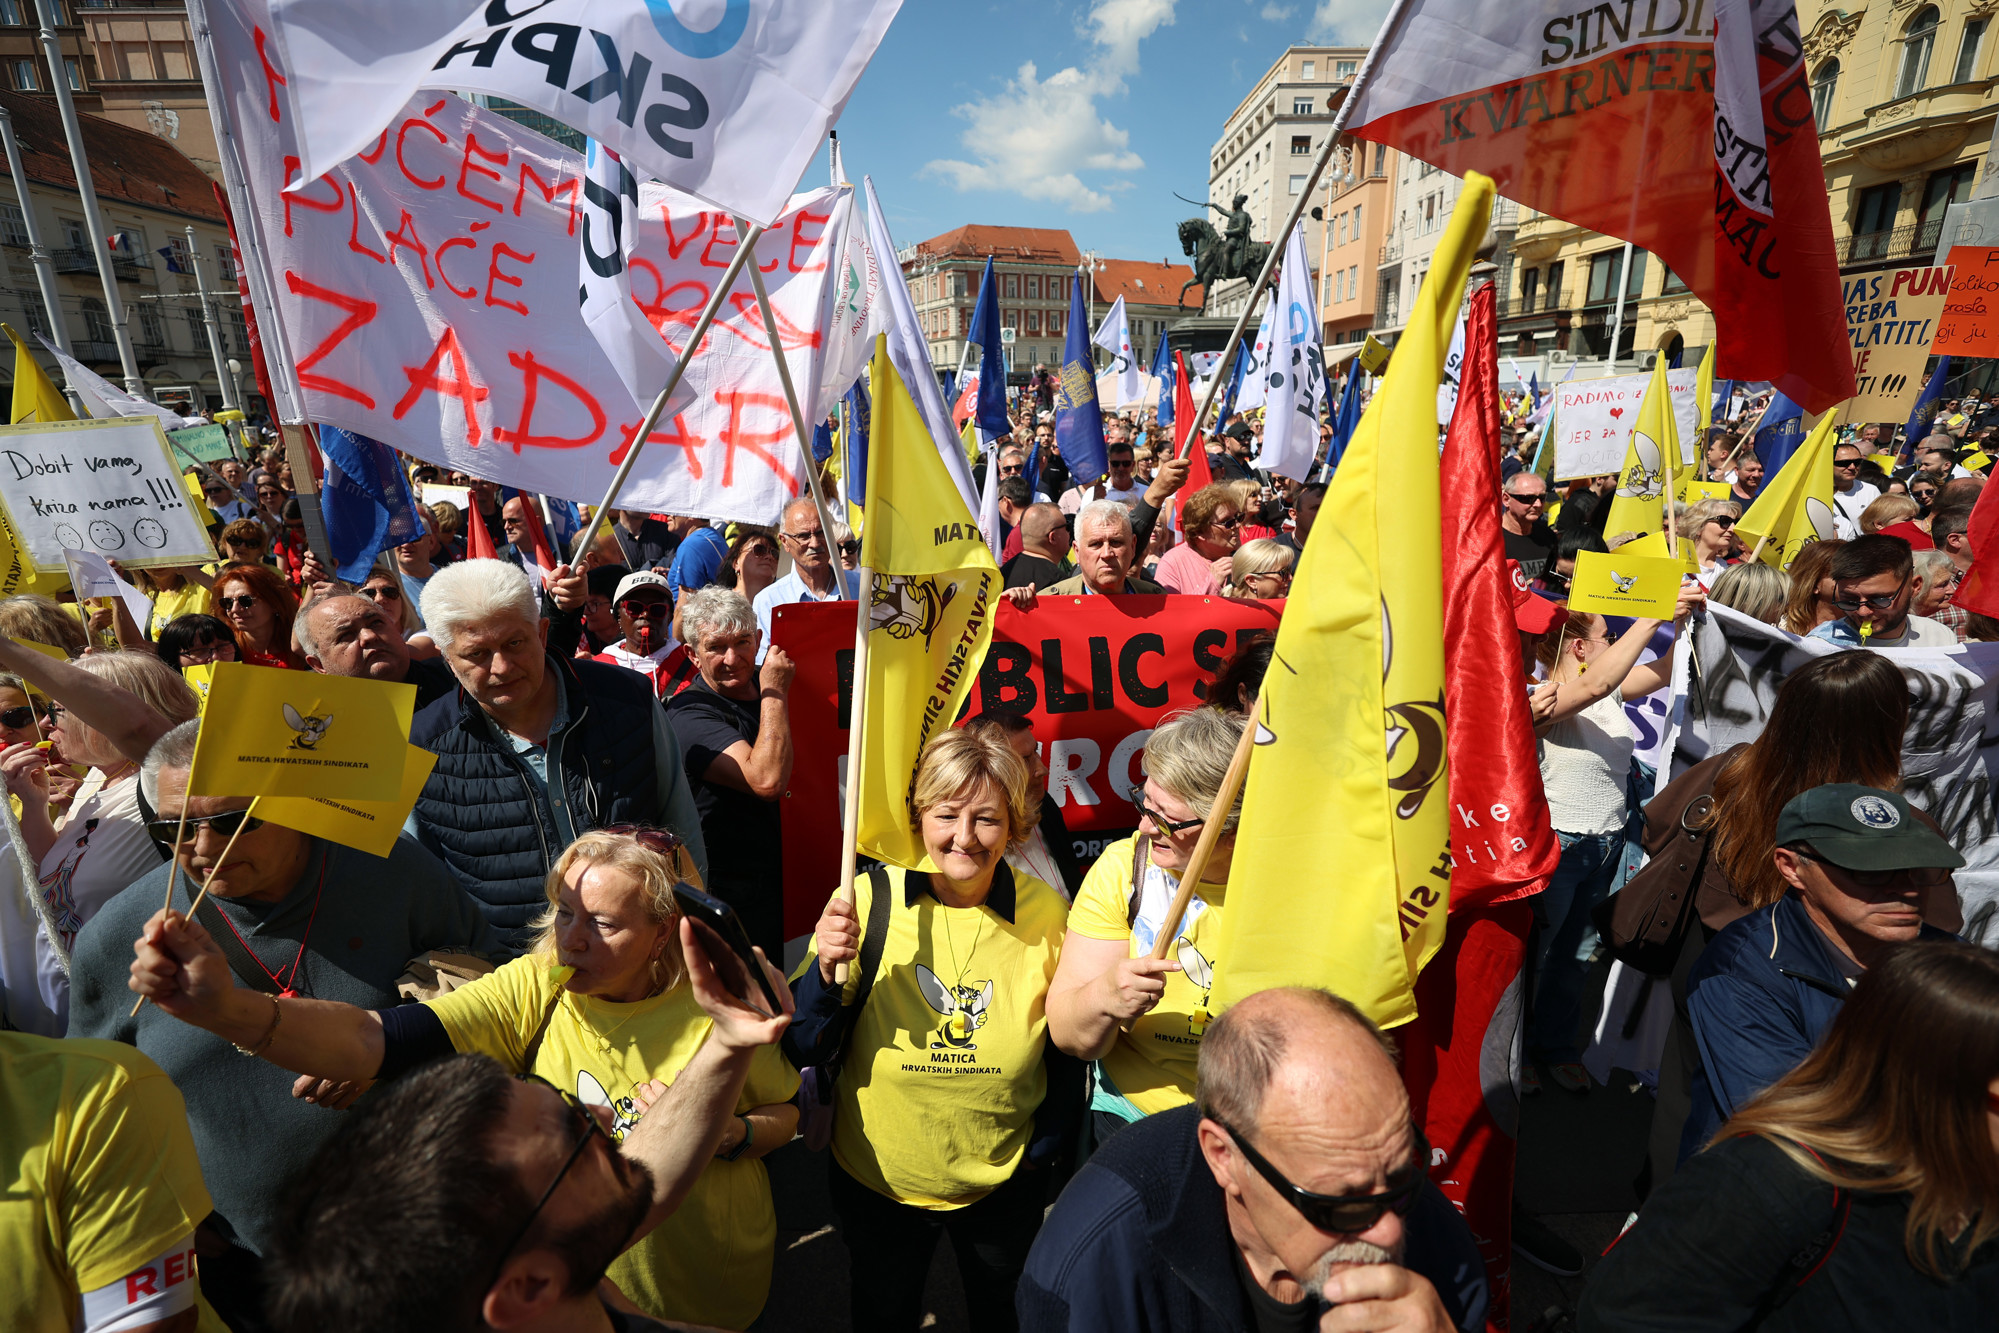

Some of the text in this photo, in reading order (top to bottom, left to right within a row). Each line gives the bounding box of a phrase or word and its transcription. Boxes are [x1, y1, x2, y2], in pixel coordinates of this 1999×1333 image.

[1542, 0, 1714, 66] SINDI
[1846, 300, 1897, 324] REBA
[286, 269, 799, 498] ZADAR
[1563, 391, 1625, 409] RADIMO
[3, 450, 143, 481] Dobit vama,
[934, 521, 984, 547] MATI
[238, 755, 369, 769] MATICA HRVATSKIH SINDIKATA
[901, 1064, 952, 1074] HRVATSKIH
[930, 1053, 977, 1063] MATICA
